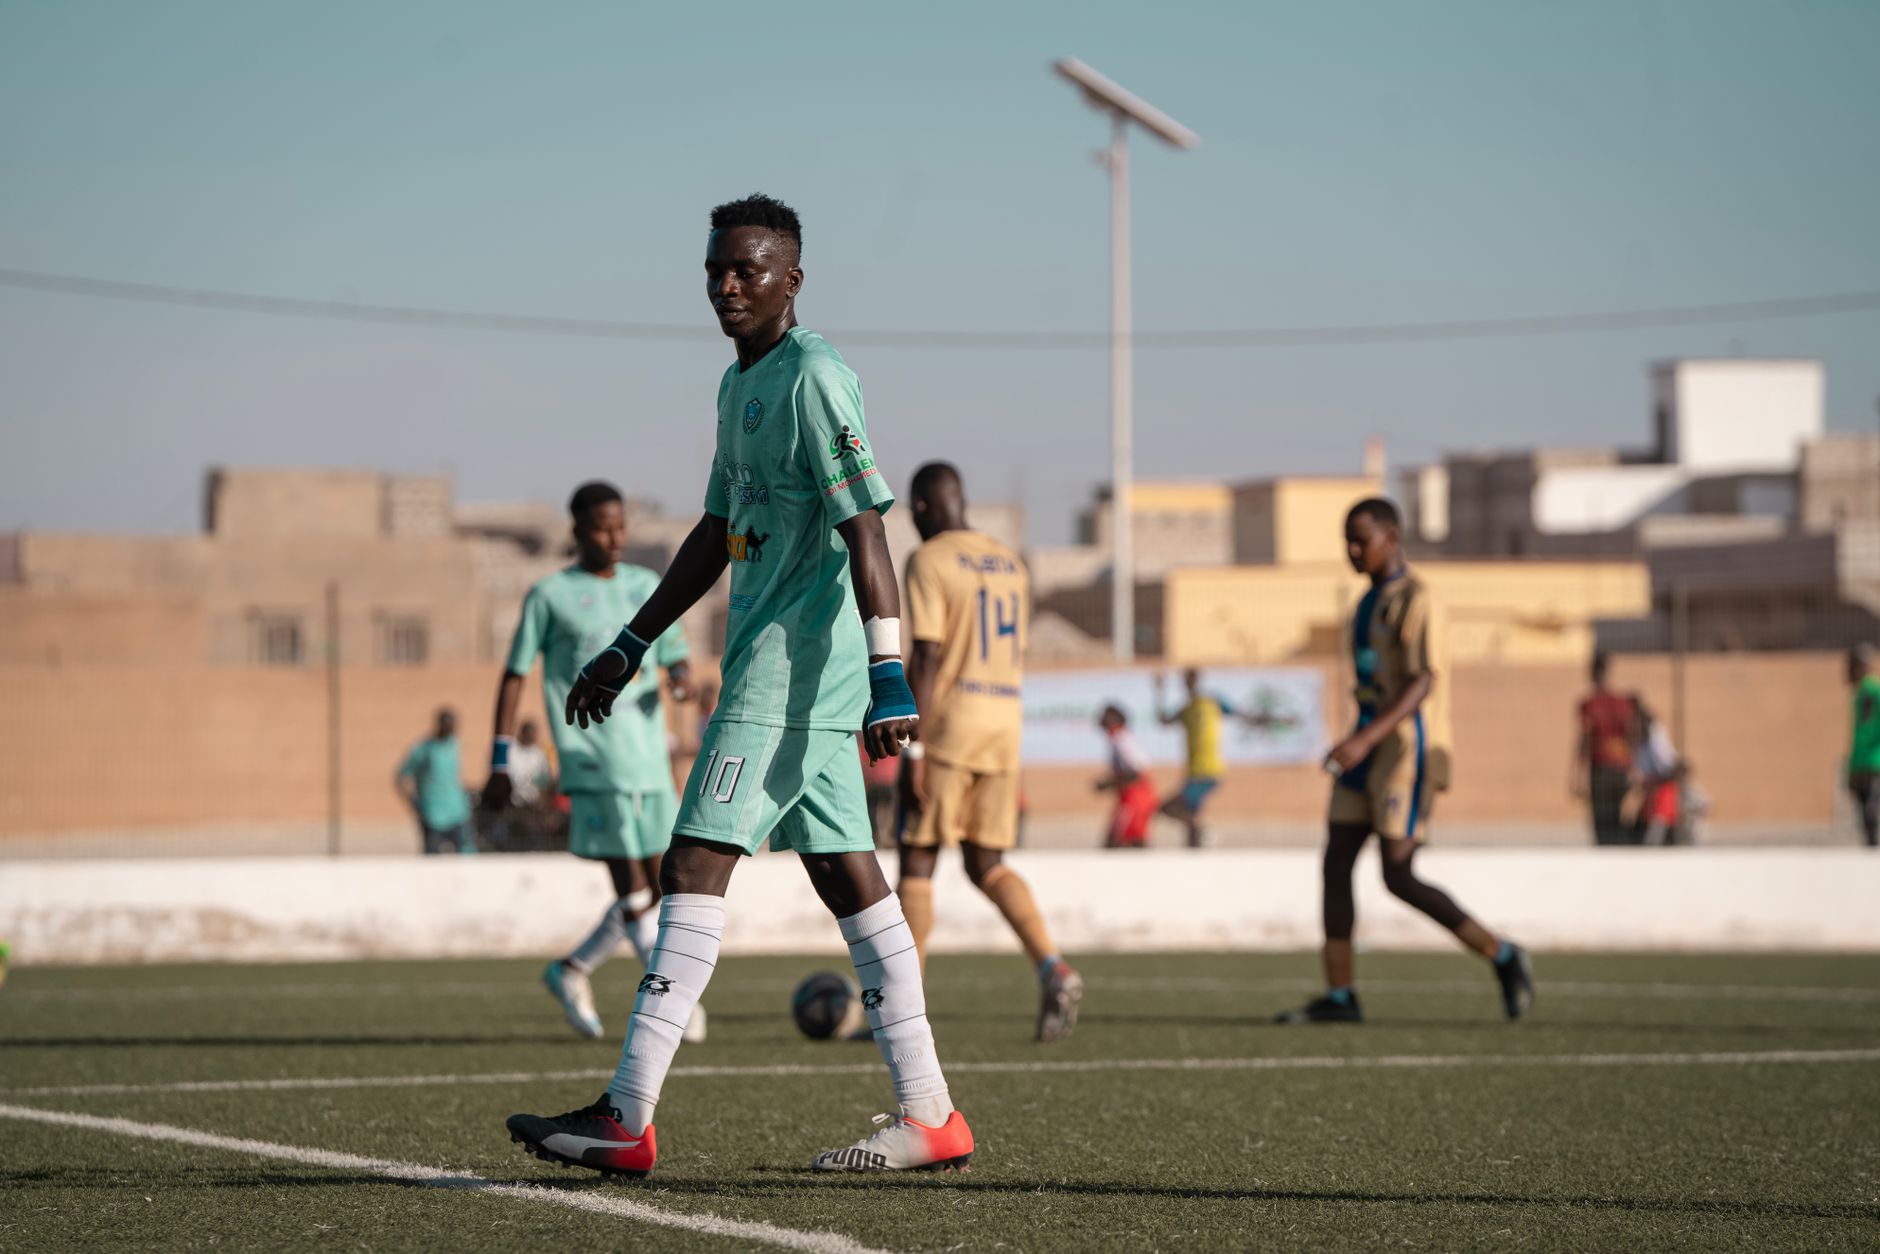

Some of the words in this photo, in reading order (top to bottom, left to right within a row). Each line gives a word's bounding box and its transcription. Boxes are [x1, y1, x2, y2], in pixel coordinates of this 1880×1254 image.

[978, 586, 1019, 667] 14
[699, 748, 746, 804] 10
[819, 1148, 889, 1171] PUMA
